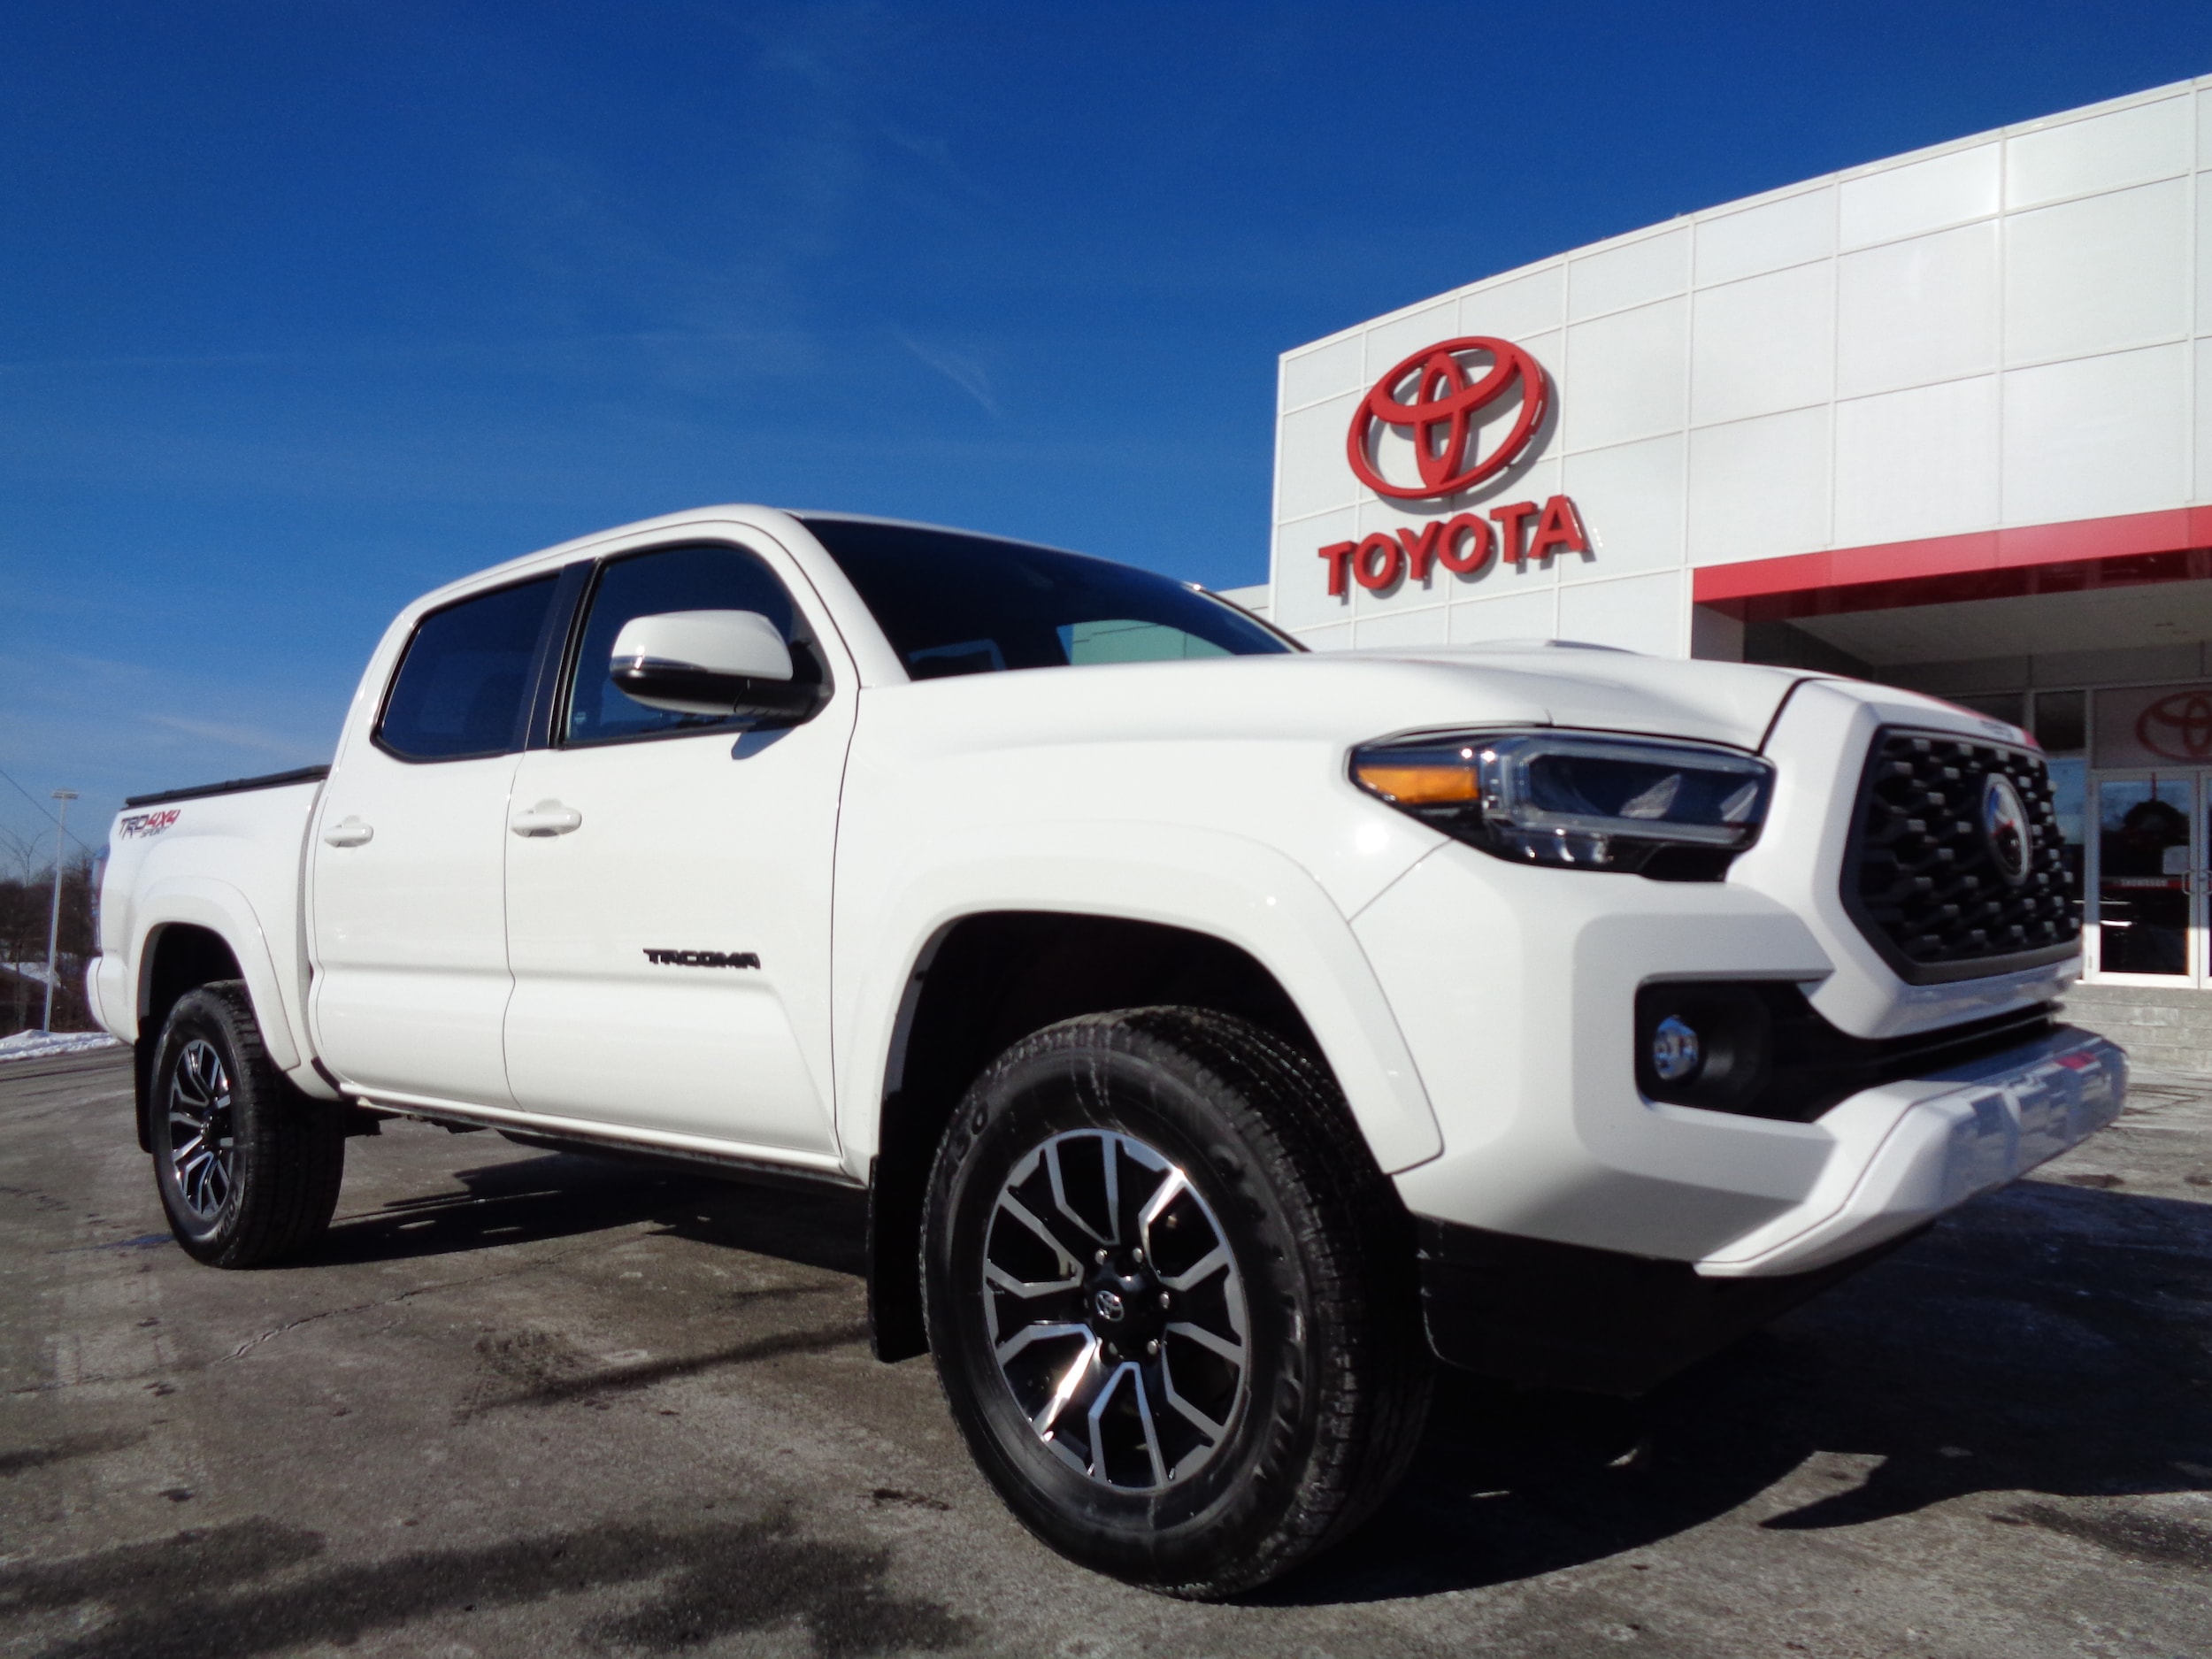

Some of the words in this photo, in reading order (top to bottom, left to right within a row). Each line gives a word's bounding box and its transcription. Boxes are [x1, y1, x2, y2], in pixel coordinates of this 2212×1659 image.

[1318, 494, 1588, 595] TOYOTA
[119, 814, 150, 840] TRD
[642, 949, 761, 970] TACOMA
